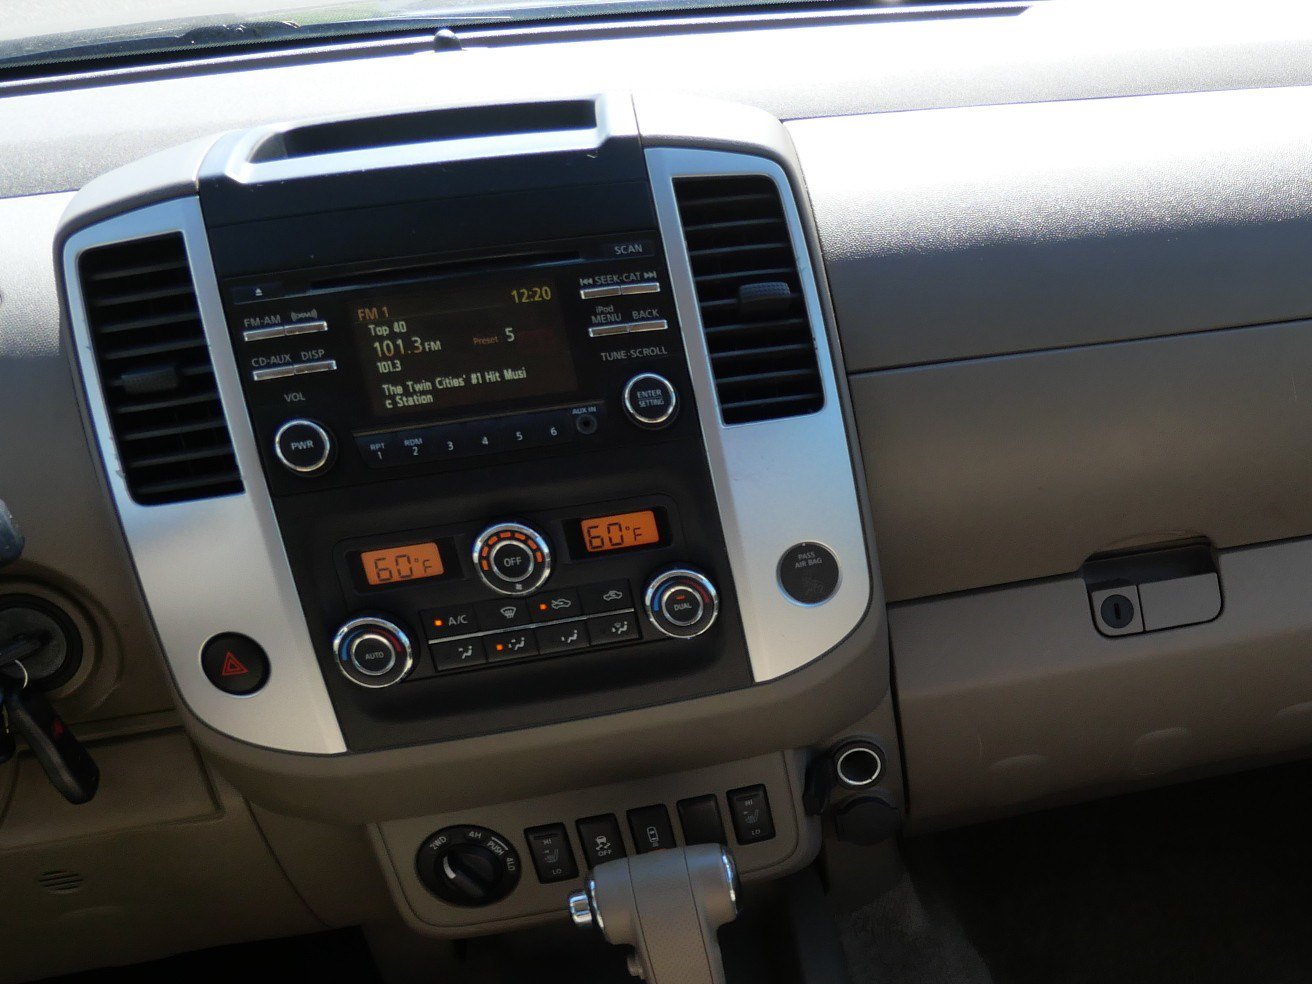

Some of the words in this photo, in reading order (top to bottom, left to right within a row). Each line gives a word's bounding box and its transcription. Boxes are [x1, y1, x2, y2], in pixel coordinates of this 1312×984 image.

[614, 244, 643, 255] SCAN
[511, 286, 552, 304] 12:20
[357, 308, 378, 321] FM
[381, 306, 390, 318] 1
[595, 305, 614, 314] iPod
[632, 308, 660, 320] BACK
[591, 312, 622, 324] MENU
[368, 324, 390, 337] Top
[393, 321, 408, 334] 40
[504, 327, 515, 342] 5
[373, 336, 424, 358] 101.3
[424, 340, 442, 352] FM
[300, 348, 325, 361] DISP
[376, 359, 402, 374] 101.3
[382, 383, 404, 397] The
[406, 379, 433, 393] Twin
[435, 374, 467, 389] Cities'
[470, 371, 483, 385] #1
[485, 370, 501, 382] Hit
[503, 366, 527, 381] Musi
[284, 392, 306, 402] VOL
[636, 389, 663, 399] ENTER
[385, 399, 394, 409] c
[396, 392, 434, 407] Station
[638, 399, 665, 408] SETTING
[571, 407, 588, 415] AUX
[588, 405, 597, 413] IN
[516, 431, 524, 442] 5
[550, 426, 558, 437] 6
[291, 440, 314, 451] PWR
[404, 437, 423, 447] RDM
[447, 441, 455, 451] 3
[481, 436, 490, 446] 4
[377, 451, 383, 460] 1
[412, 446, 420, 457] 2
[503, 556, 522, 568] OFF
[673, 602, 693, 611] DUAL
[448, 614, 469, 627] A/C
[365, 651, 385, 661] AUTO
[468, 831, 482, 839] 4H
[429, 836, 447, 850] 2WD
[486, 840, 505, 856] PUSH
